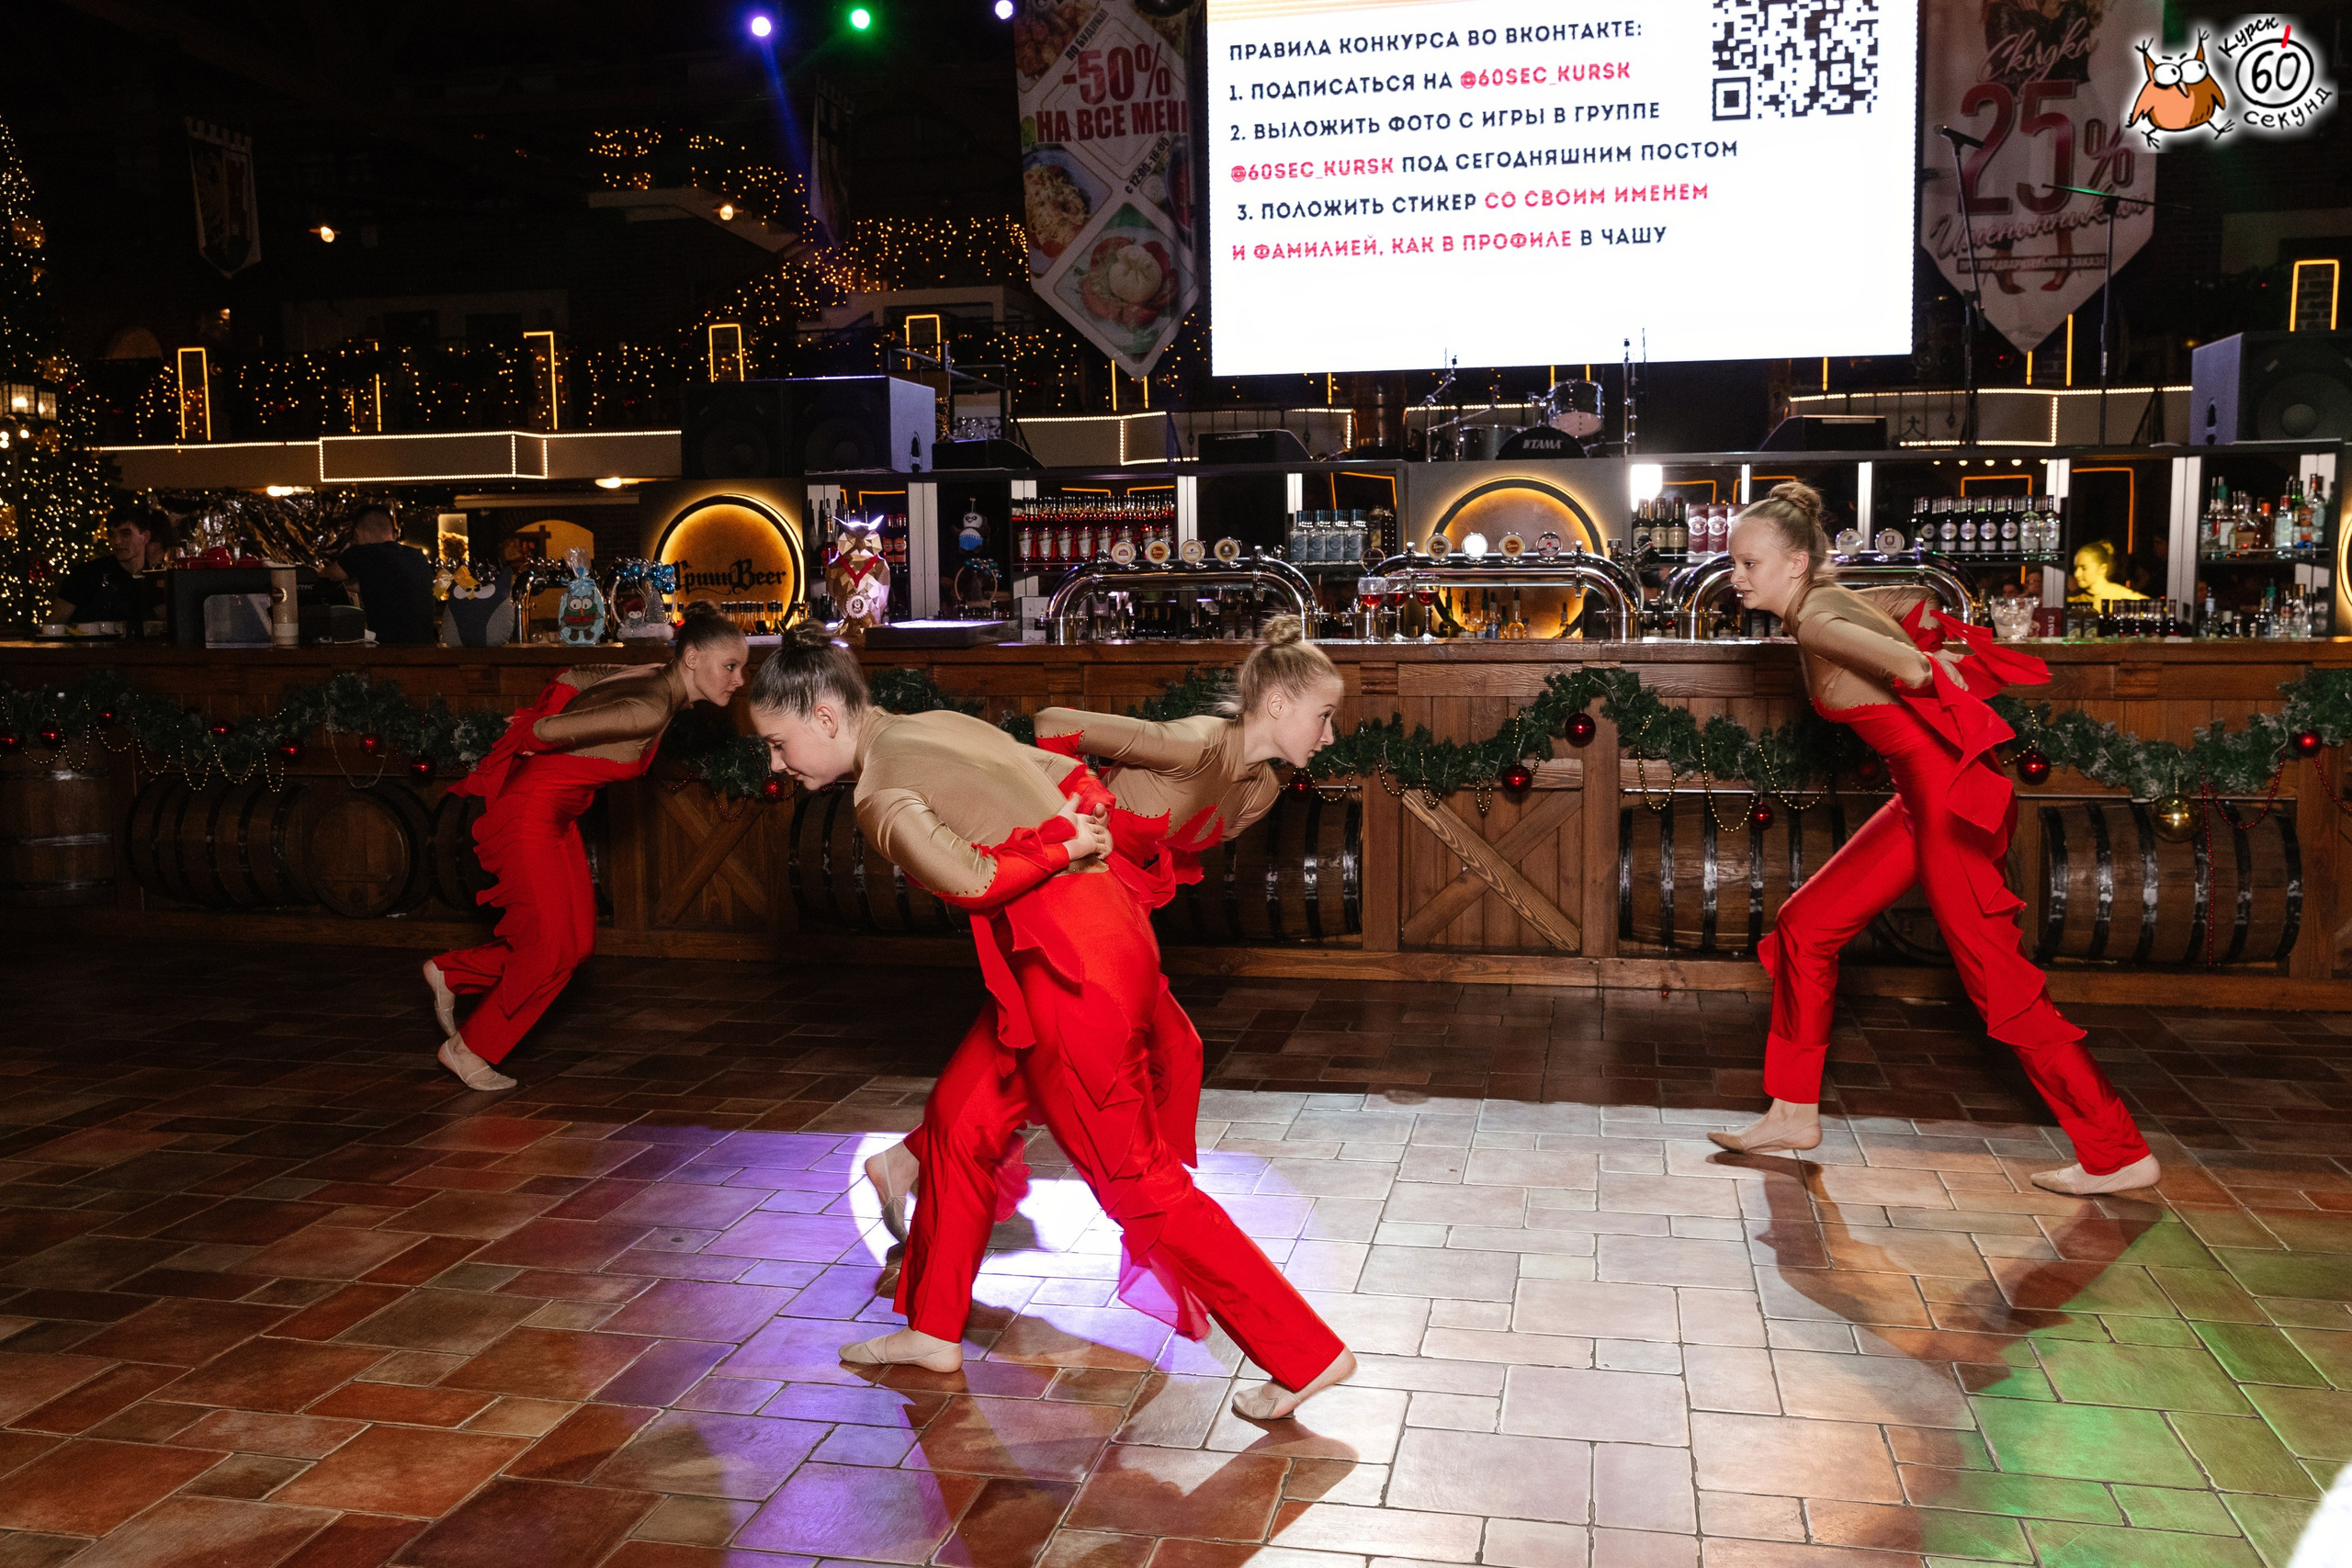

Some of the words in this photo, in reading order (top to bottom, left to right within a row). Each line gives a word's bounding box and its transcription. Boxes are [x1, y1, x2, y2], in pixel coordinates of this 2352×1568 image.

[1230, 39, 1331, 61] ПРАВИЛА
[1340, 31, 1459, 53] КОНКУРСА
[1468, 29, 1497, 46] ВО
[1506, 20, 1641, 43] ВКОНТАКТЕ:
[1062, 42, 1171, 105] -50%
[1977, 17, 2099, 104] Скидка
[1229, 85, 1242, 101] 1.
[1251, 74, 1414, 99] ПОДПИСАТЬСЯ
[1424, 72, 1453, 89] НА
[1461, 62, 1630, 89] @60SEC_KURSK
[1035, 110, 1072, 142] НА
[1076, 105, 1126, 141] ВСЕ
[1230, 125, 1246, 141] 2.
[1254, 118, 1380, 140] ВЫЛОЖИТЬ
[1388, 113, 1451, 131] ФОТО
[1459, 112, 1473, 128] С
[1483, 108, 1544, 127] ИГРЫ
[1555, 107, 1566, 123] В
[1576, 102, 1659, 122] ГРУППЕ
[1231, 158, 1394, 183] @60SEC_KURSK
[1403, 155, 1448, 173] ПОД
[1456, 146, 1631, 169] СЕГОДНЯШНИМ
[1642, 141, 1736, 161] ПОСТОМ
[1238, 204, 1252, 220] 3.
[1262, 198, 1384, 220] ПОЛОЖИТЬ
[1392, 194, 1476, 213] СТИКЕР
[1485, 191, 1516, 209] СО
[1525, 188, 1604, 207] СВОИМ
[1615, 184, 1707, 202] ИМЕНЕМ
[1233, 245, 1245, 260] И
[1254, 235, 1383, 259] ФАМИЛИЕЙ,
[1392, 237, 1433, 254] КАК
[1442, 236, 1453, 252] В
[1464, 231, 1571, 251] ПРОФИЛЕ
[1581, 230, 1592, 245] В
[1601, 227, 1667, 244] ЧАШУ
[1530, 439, 1562, 449] TAMA
